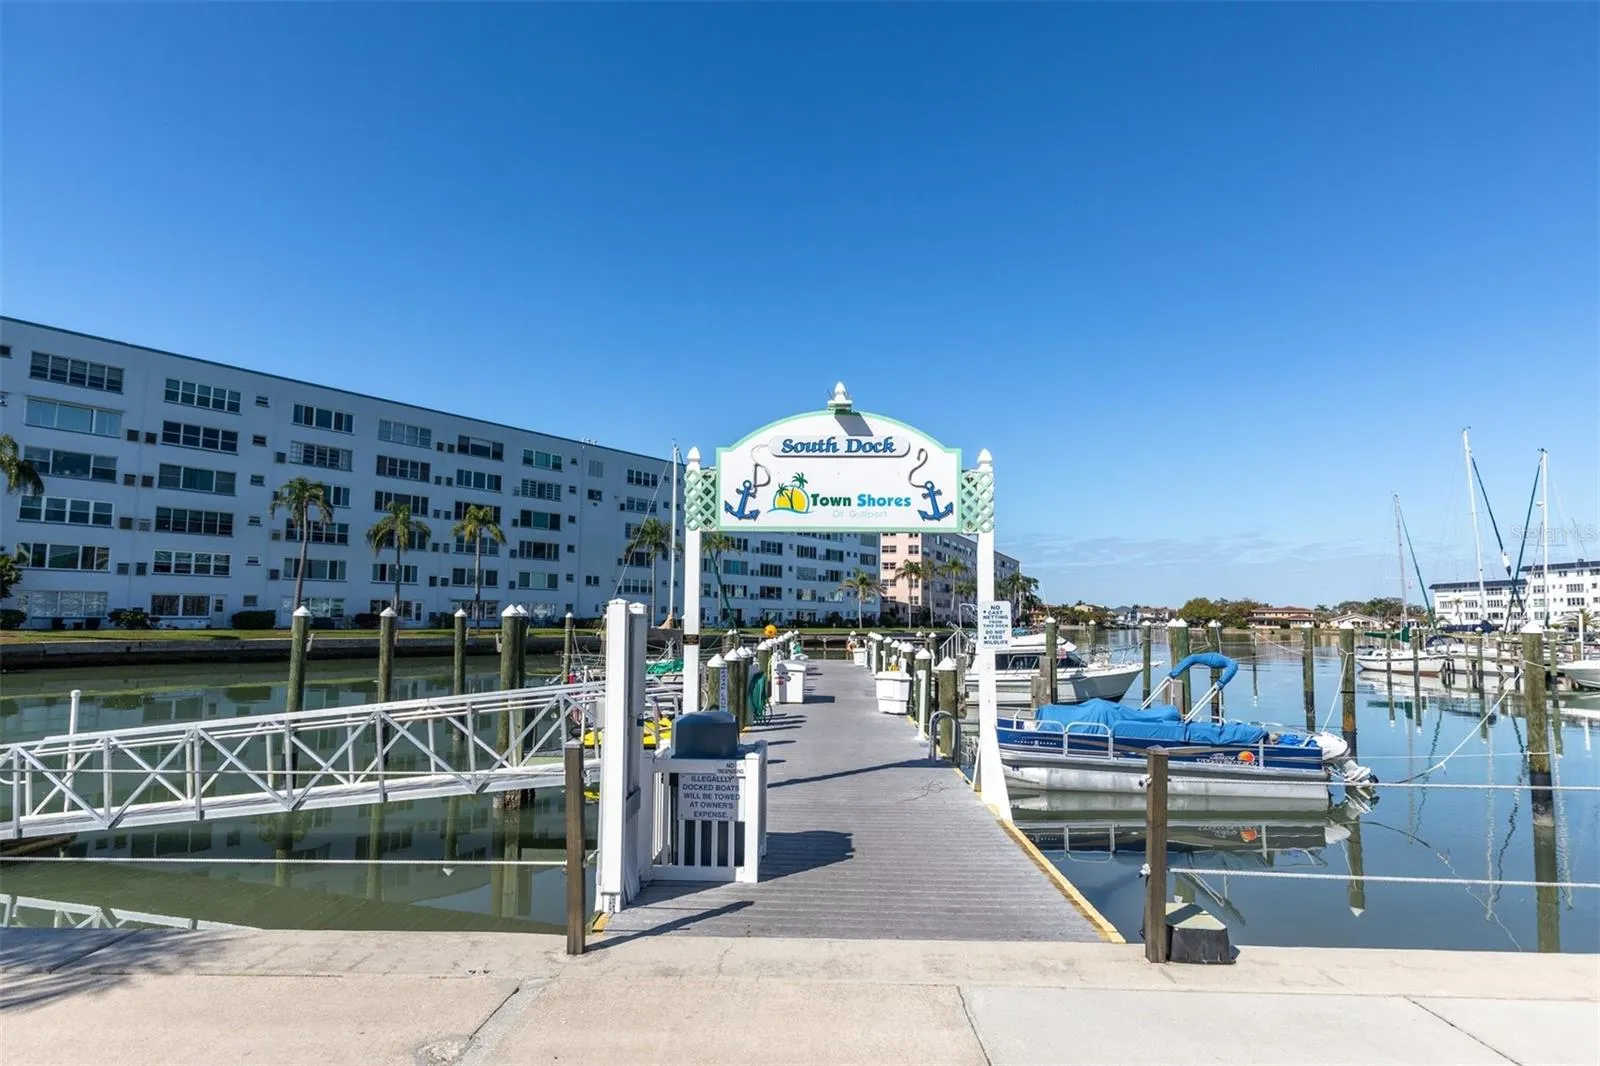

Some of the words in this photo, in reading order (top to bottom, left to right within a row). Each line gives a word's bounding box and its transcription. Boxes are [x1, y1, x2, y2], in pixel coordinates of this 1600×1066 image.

[781, 436, 839, 454] South
[845, 436, 896, 454] Dock
[810, 493, 851, 507] Town
[857, 493, 911, 507] Shores
[848, 509, 888, 519] Gulfport
[682, 783, 714, 791] DOCKED
[715, 784, 740, 792] BOATS
[683, 792, 701, 800] WILL
[714, 793, 740, 801] TOWED
